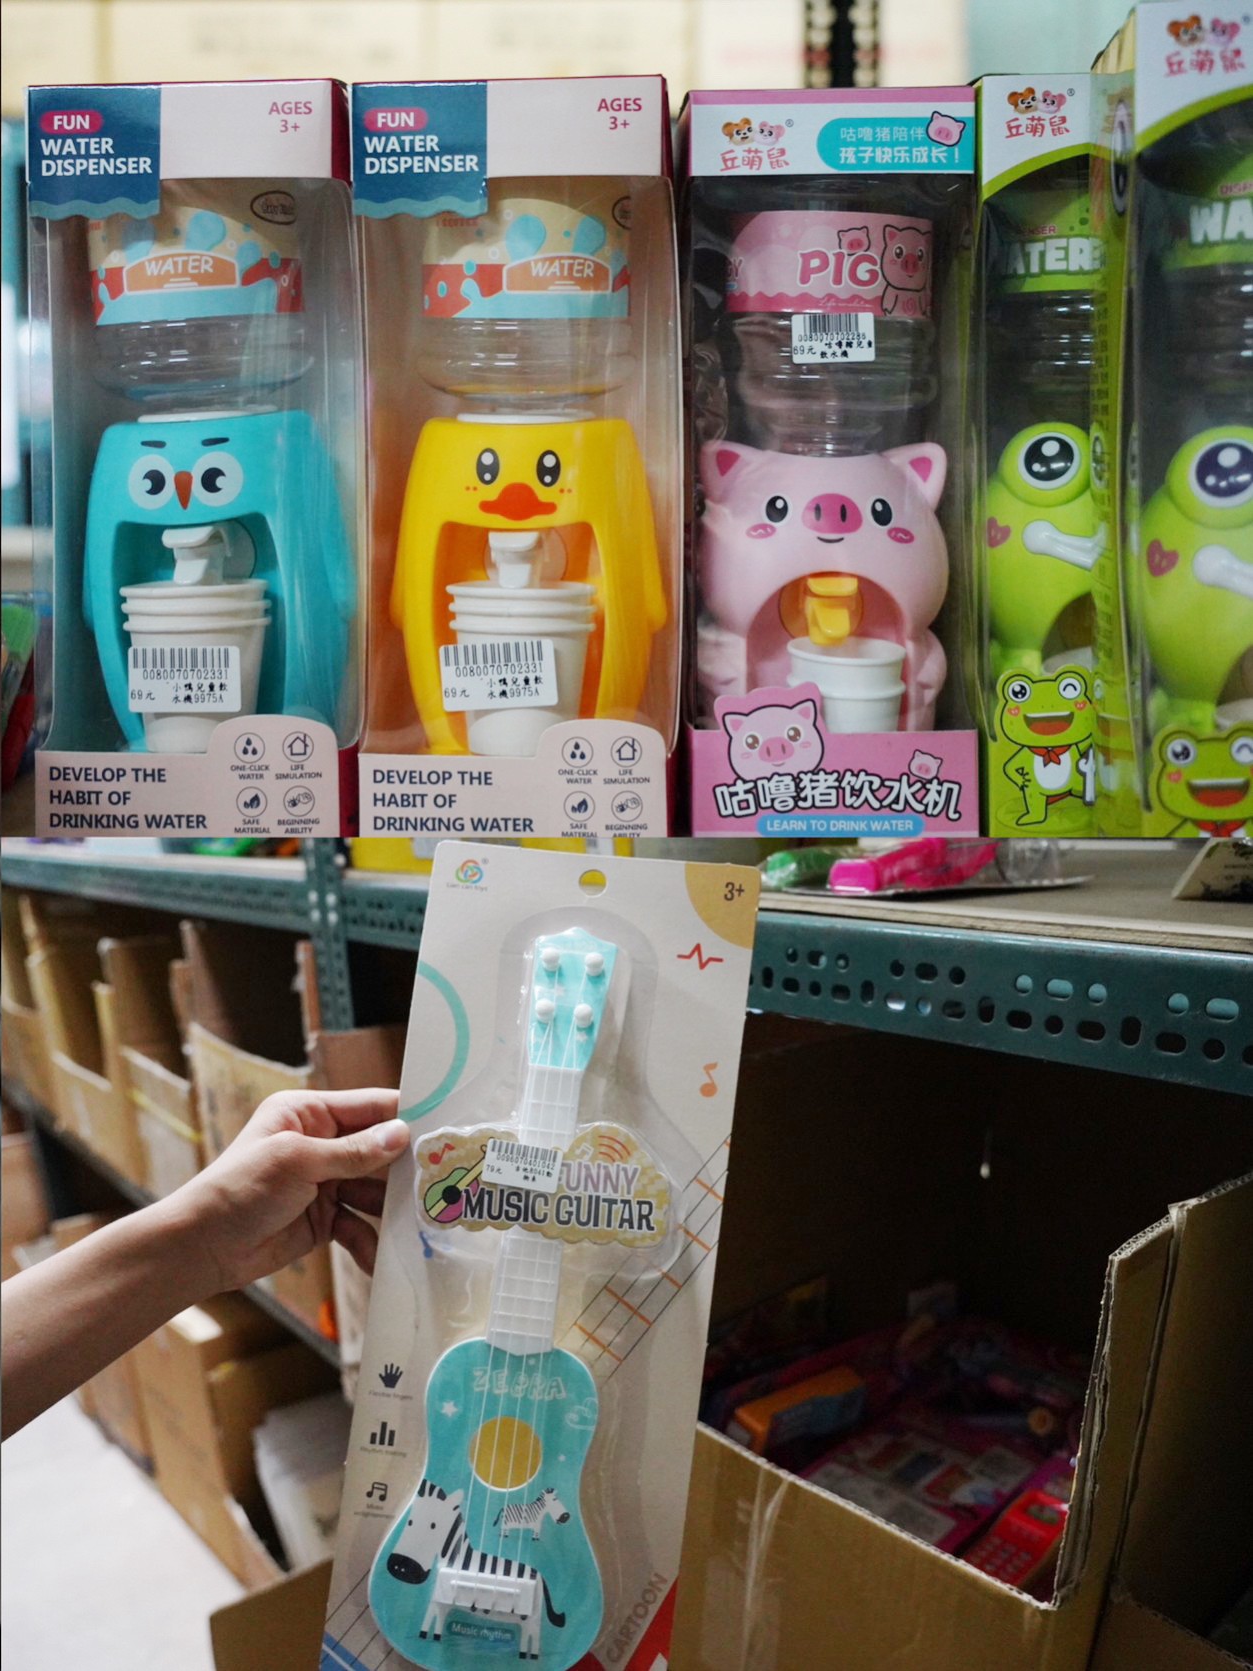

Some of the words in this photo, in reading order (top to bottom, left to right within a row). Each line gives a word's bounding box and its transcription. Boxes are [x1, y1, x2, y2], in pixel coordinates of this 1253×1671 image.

[268, 101, 313, 116] AGES
[597, 97, 643, 113] AGES
[53, 114, 90, 130] FUN
[279, 119, 301, 134] 3+
[377, 112, 415, 128] FUN
[609, 116, 630, 131] 3+
[1004, 114, 1071, 140] 丘萌鼠
[840, 126, 926, 143] 咕噜猪陪伴
[40, 137, 115, 156] WATER
[364, 134, 440, 153] WATER
[41, 157, 153, 177] DISPENSER
[364, 154, 480, 175] DISPENSER
[719, 146, 791, 172] 丘萌鼠
[145, 255, 213, 276] WATER
[530, 259, 594, 278] WATER
[798, 249, 881, 289] PIG
[793, 345, 817, 355] 69元
[142, 669, 229, 680] 0080070702331
[455, 662, 543, 678] 0080070702331
[130, 689, 155, 701] 69元
[444, 687, 470, 698] 69元
[49, 766, 127, 783] DEVELOP
[131, 768, 167, 783] THE
[275, 772, 323, 780] SIMULATION
[373, 769, 452, 785] DEVELOP
[457, 771, 493, 786] THE
[566, 777, 592, 785] WATER
[603, 777, 651, 785] SIMULATION
[49, 789, 103, 805] HABIT
[107, 791, 131, 805] OF
[373, 792, 428, 808] HABIT
[433, 794, 457, 808] OF
[713, 768, 962, 821] 咕噜猪饮水机
[49, 813, 139, 829] DRINKING
[145, 814, 208, 829] WATER
[277, 818, 320, 826] BEGINNING
[373, 816, 465, 832] DRINKING
[470, 817, 535, 832] WATER
[605, 823, 648, 831] BEGINNING
[766, 819, 808, 831] LEARN
[809, 819, 827, 831] TO
[830, 819, 868, 831] DRINK
[870, 819, 914, 831] WATER
[723, 882, 745, 901] 3+
[486, 1163, 503, 1175] 79元
[560, 1161, 640, 1196] UNNY
[463, 1187, 549, 1224] MUSIC
[554, 1194, 655, 1231] GUITAR
[606, 1572, 669, 1665] CARTOON
[451, 1622, 478, 1638] Music
[480, 1626, 513, 1643] rhythm
